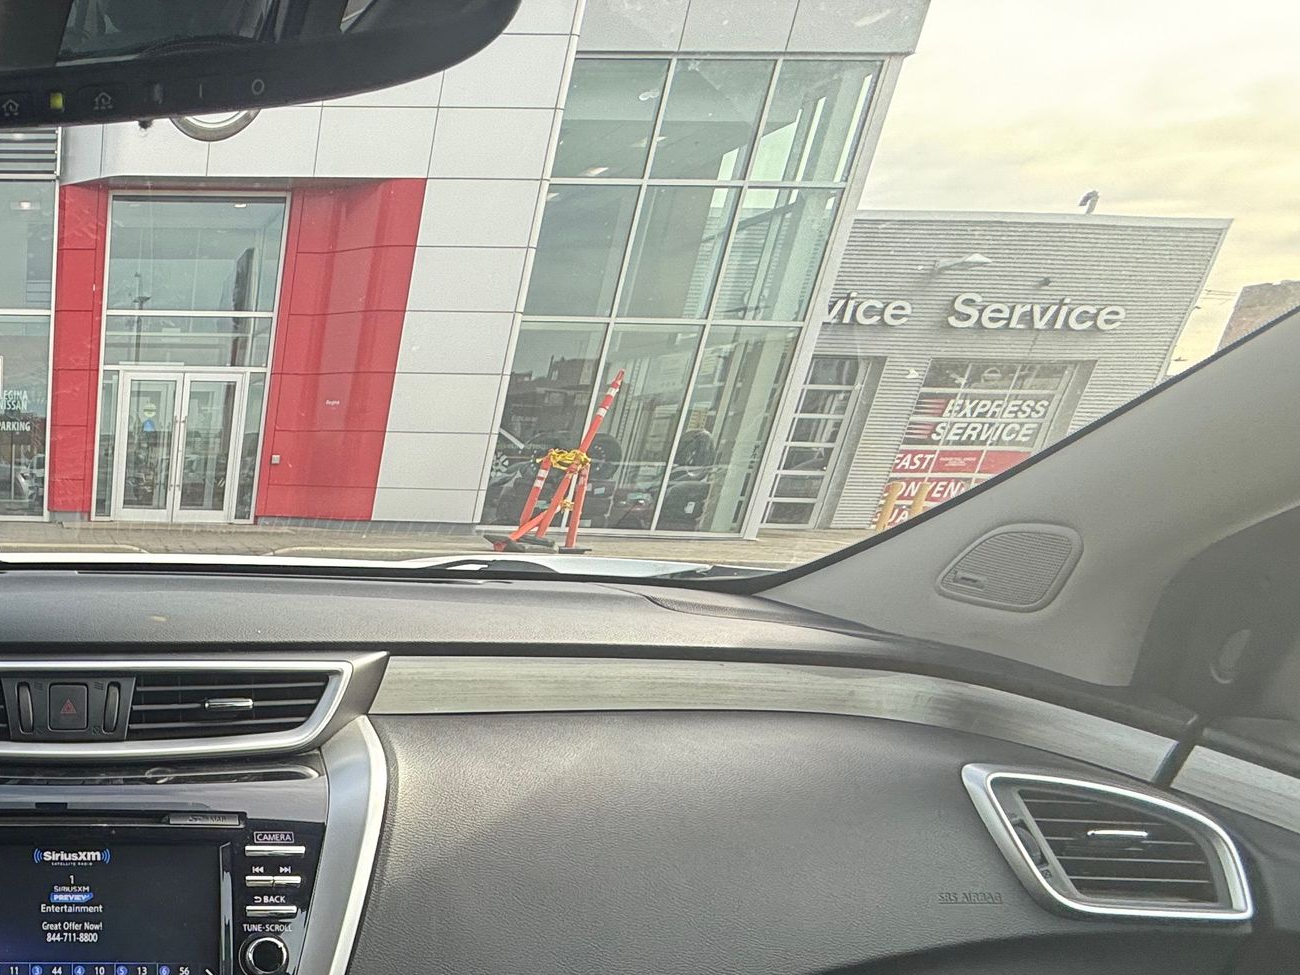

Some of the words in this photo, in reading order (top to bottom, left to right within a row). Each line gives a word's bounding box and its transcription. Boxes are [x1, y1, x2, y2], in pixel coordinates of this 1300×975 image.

[947, 292, 1127, 331] Service
[3, 390, 28, 400] EGINA
[942, 400, 1050, 418] EXPRESS
[931, 422, 1037, 442] SERVICE
[894, 454, 936, 470] FAST
[938, 892, 958, 902] SRS
[962, 892, 1002, 902] AIRBAG
[40, 904, 103, 913] Entertainment
[42, 921, 61, 930] Great
[63, 921, 82, 930] Offer
[84, 921, 103, 930] Now!
[46, 932, 98, 942] 844-711-8800
[10, 966, 19, 975] 11
[52, 966, 62, 975] 44
[95, 967, 105, 975] 10
[137, 967, 147, 975] 13
[179, 967, 190, 975] 56
